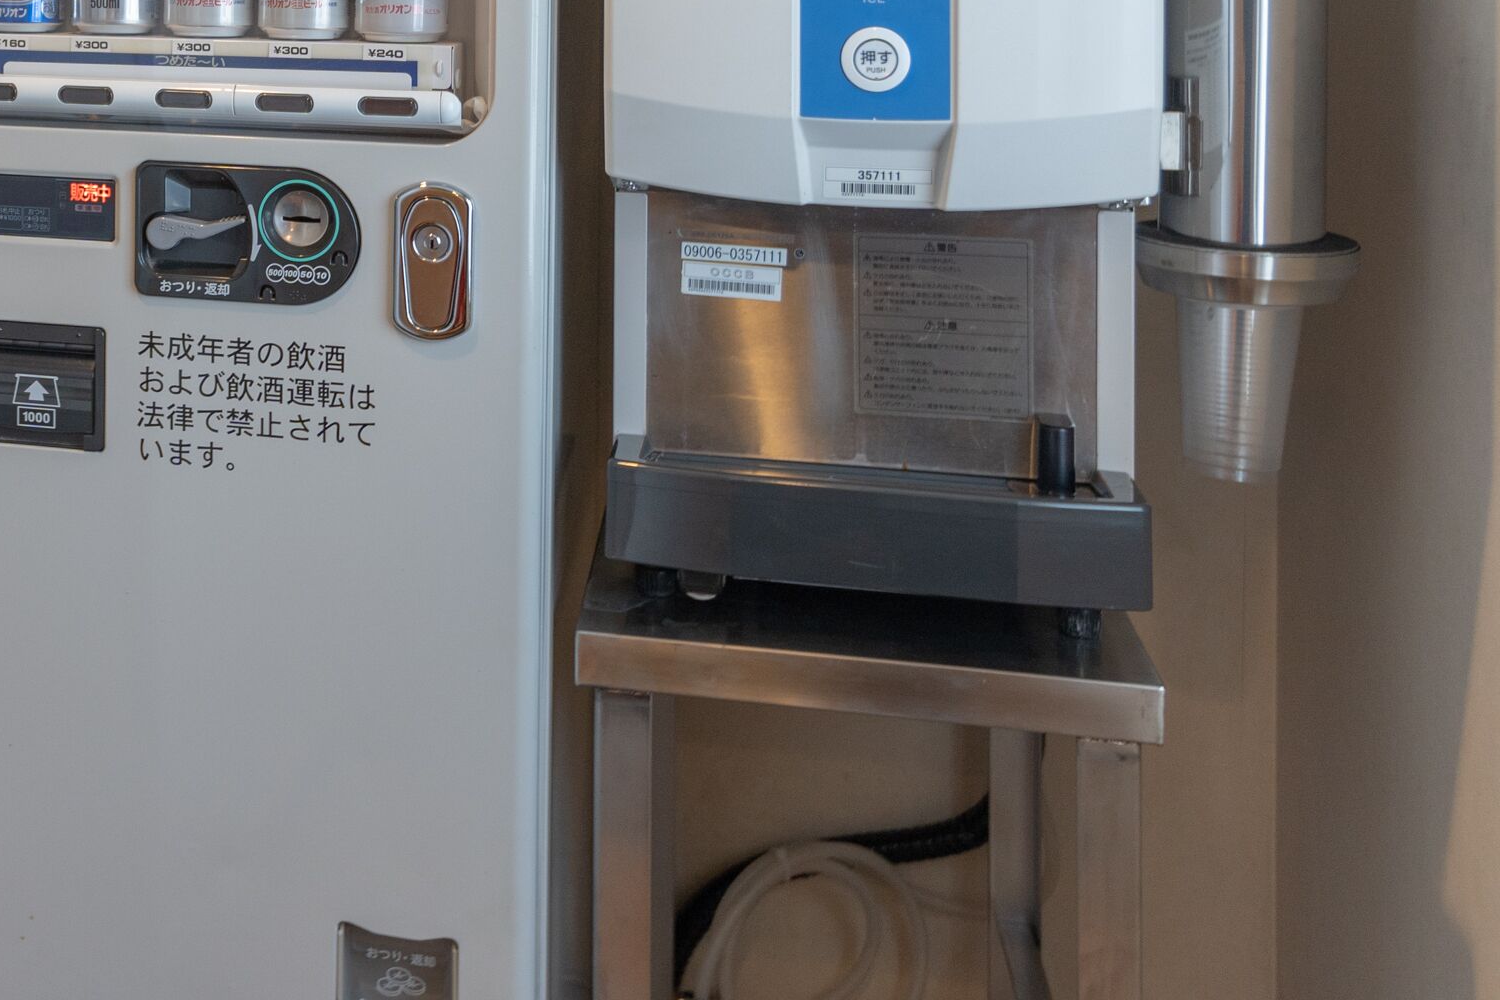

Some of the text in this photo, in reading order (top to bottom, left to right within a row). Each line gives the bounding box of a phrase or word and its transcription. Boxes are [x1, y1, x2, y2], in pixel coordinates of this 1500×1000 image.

[75, 40, 108, 50] ¥300
[177, 43, 211, 52] ¥300
[274, 46, 309, 56] ¥300
[368, 48, 404, 59] ¥240
[860, 49, 893, 66] 押す
[865, 66, 887, 74] PUSH
[858, 170, 901, 182] 357111
[70, 182, 112, 204] 販売中
[683, 244, 783, 264] 09006-0357111
[315, 271, 327, 280] 10
[159, 279, 231, 297] おつり・返却
[138, 330, 346, 374] 未成年者の飲酒
[139, 367, 377, 411] および飲酒運転は
[22, 410, 51, 426] 1000
[137, 400, 377, 448] 法律で禁止されて
[140, 438, 236, 472] います。
